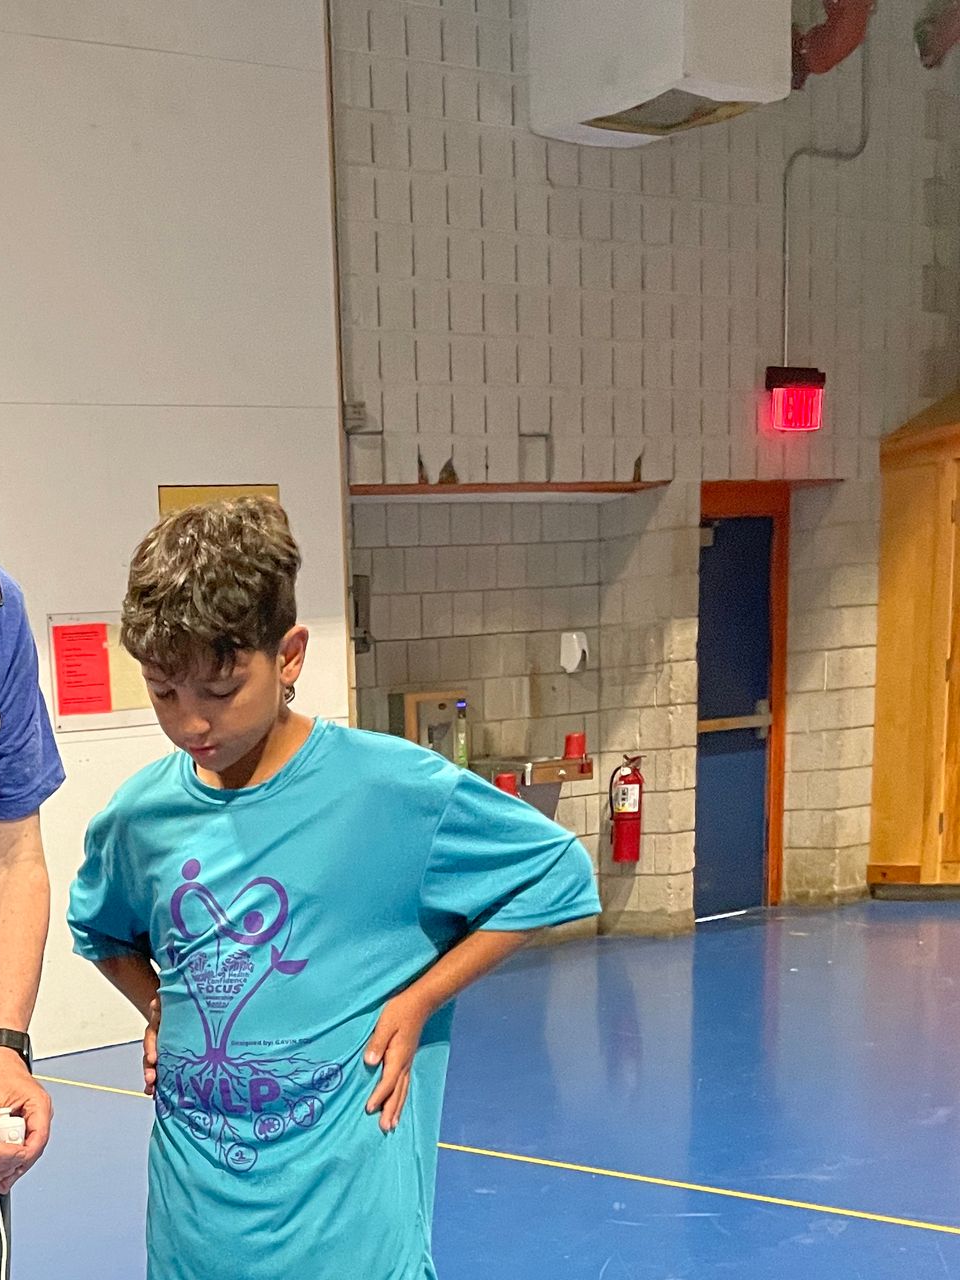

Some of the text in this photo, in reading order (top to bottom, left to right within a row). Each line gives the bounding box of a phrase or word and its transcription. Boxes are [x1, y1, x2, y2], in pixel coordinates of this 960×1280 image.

[782, 389, 817, 428] EXIT
[196, 983, 244, 995] FOCUS
[175, 1072, 281, 1114] LYLP
